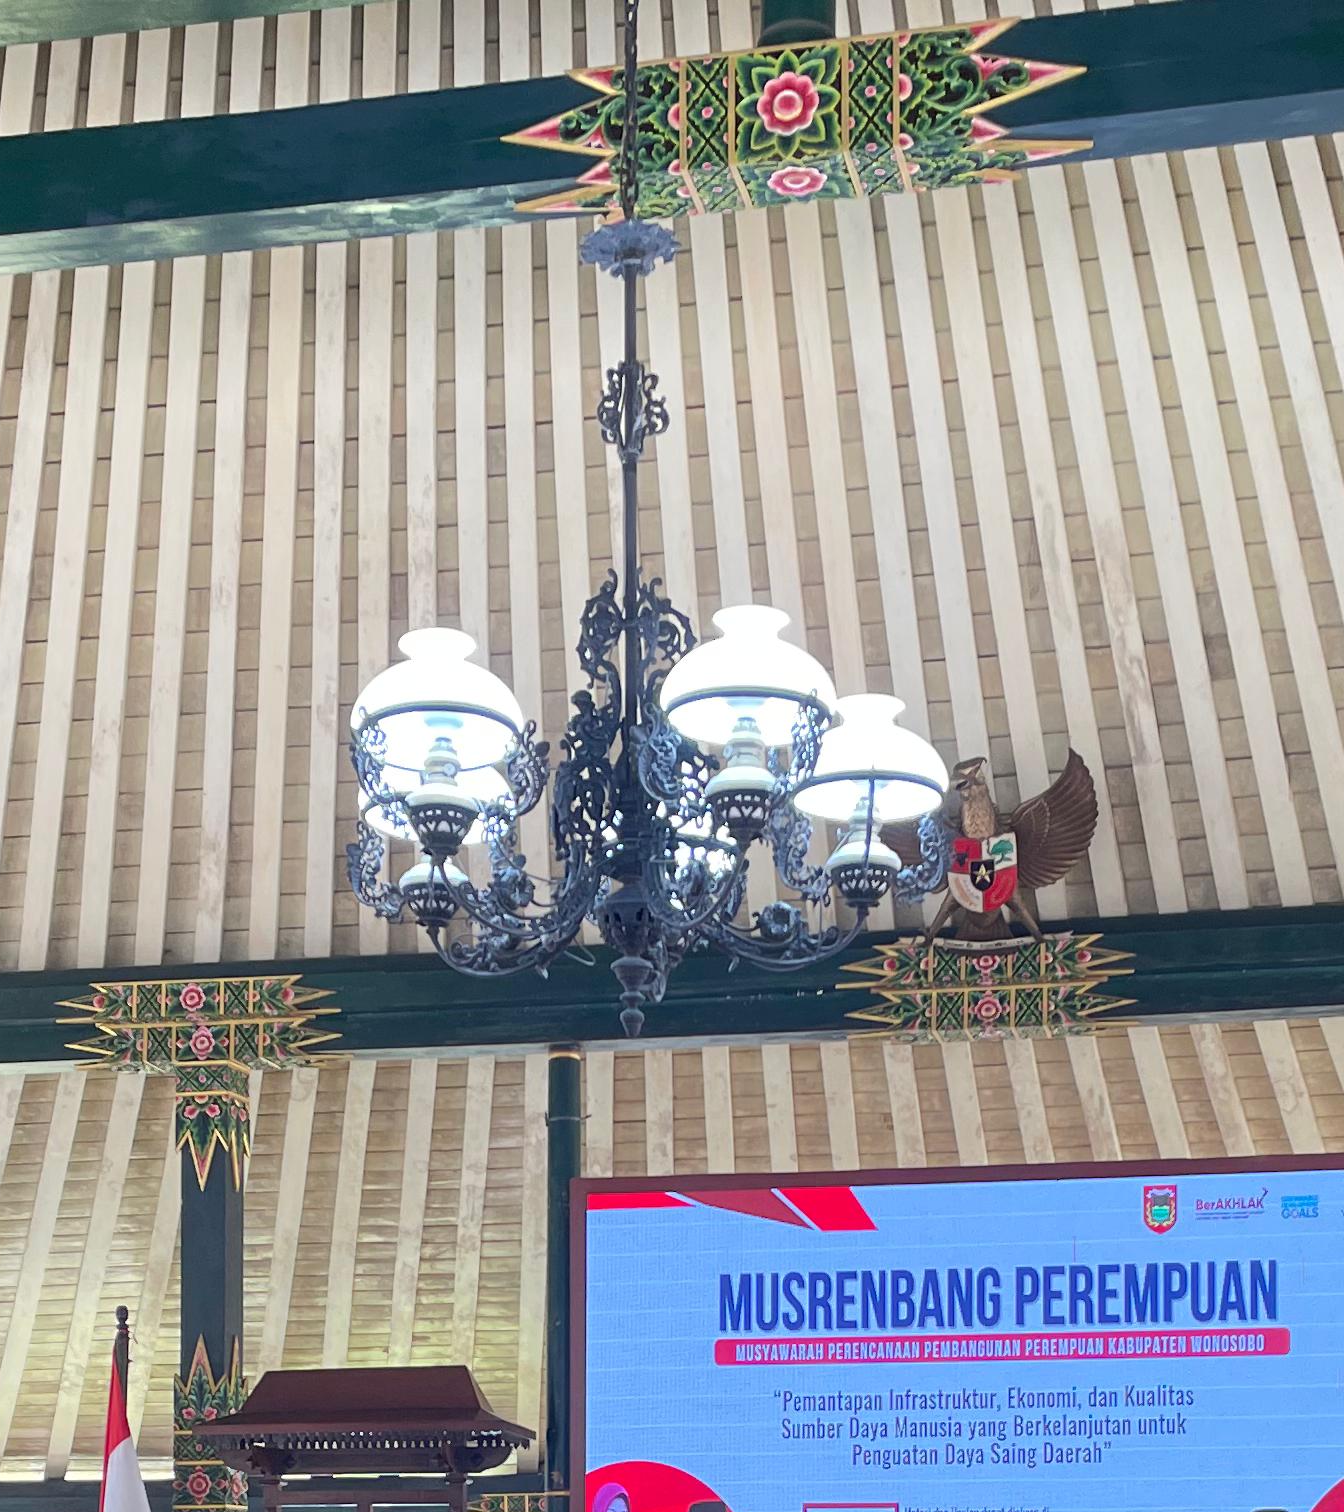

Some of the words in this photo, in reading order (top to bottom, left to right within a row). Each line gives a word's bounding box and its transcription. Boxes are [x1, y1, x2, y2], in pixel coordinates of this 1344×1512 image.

[1196, 1197, 1265, 1211] BerAKHLAK
[1281, 1207, 1319, 1219] GOALS
[719, 1267, 1001, 1332] MUSRENBANG
[1015, 1259, 1277, 1325] PEREMPUAN
[735, 1343, 824, 1362] MUSYAWARAH
[828, 1341, 920, 1360] PERENCANAAN
[924, 1339, 1021, 1358] PEMBANGUNAN
[1025, 1337, 1104, 1356] PEREMPUAN
[1108, 1335, 1187, 1355] KABUPATEN
[1191, 1333, 1265, 1352] WONOSOBO
[774, 1390, 882, 1414] “Pemantapan
[889, 1388, 1001, 1412] Infrastruktur,
[1008, 1386, 1082, 1410] Ekonomi,
[1088, 1386, 1118, 1407] dan
[1124, 1385, 1194, 1407] Kualitas
[782, 1418, 843, 1439] Sumber
[850, 1417, 888, 1442] Daya
[895, 1416, 962, 1438] Manusia
[969, 1419, 1007, 1441] yang
[1014, 1414, 1131, 1439] Berkelanjutan
[1138, 1413, 1187, 1435] untuk
[852, 1444, 938, 1469] Penguatan
[945, 1443, 984, 1468] Daya
[991, 1442, 1036, 1468] Saing
[1043, 1441, 1111, 1464] Daerah”
